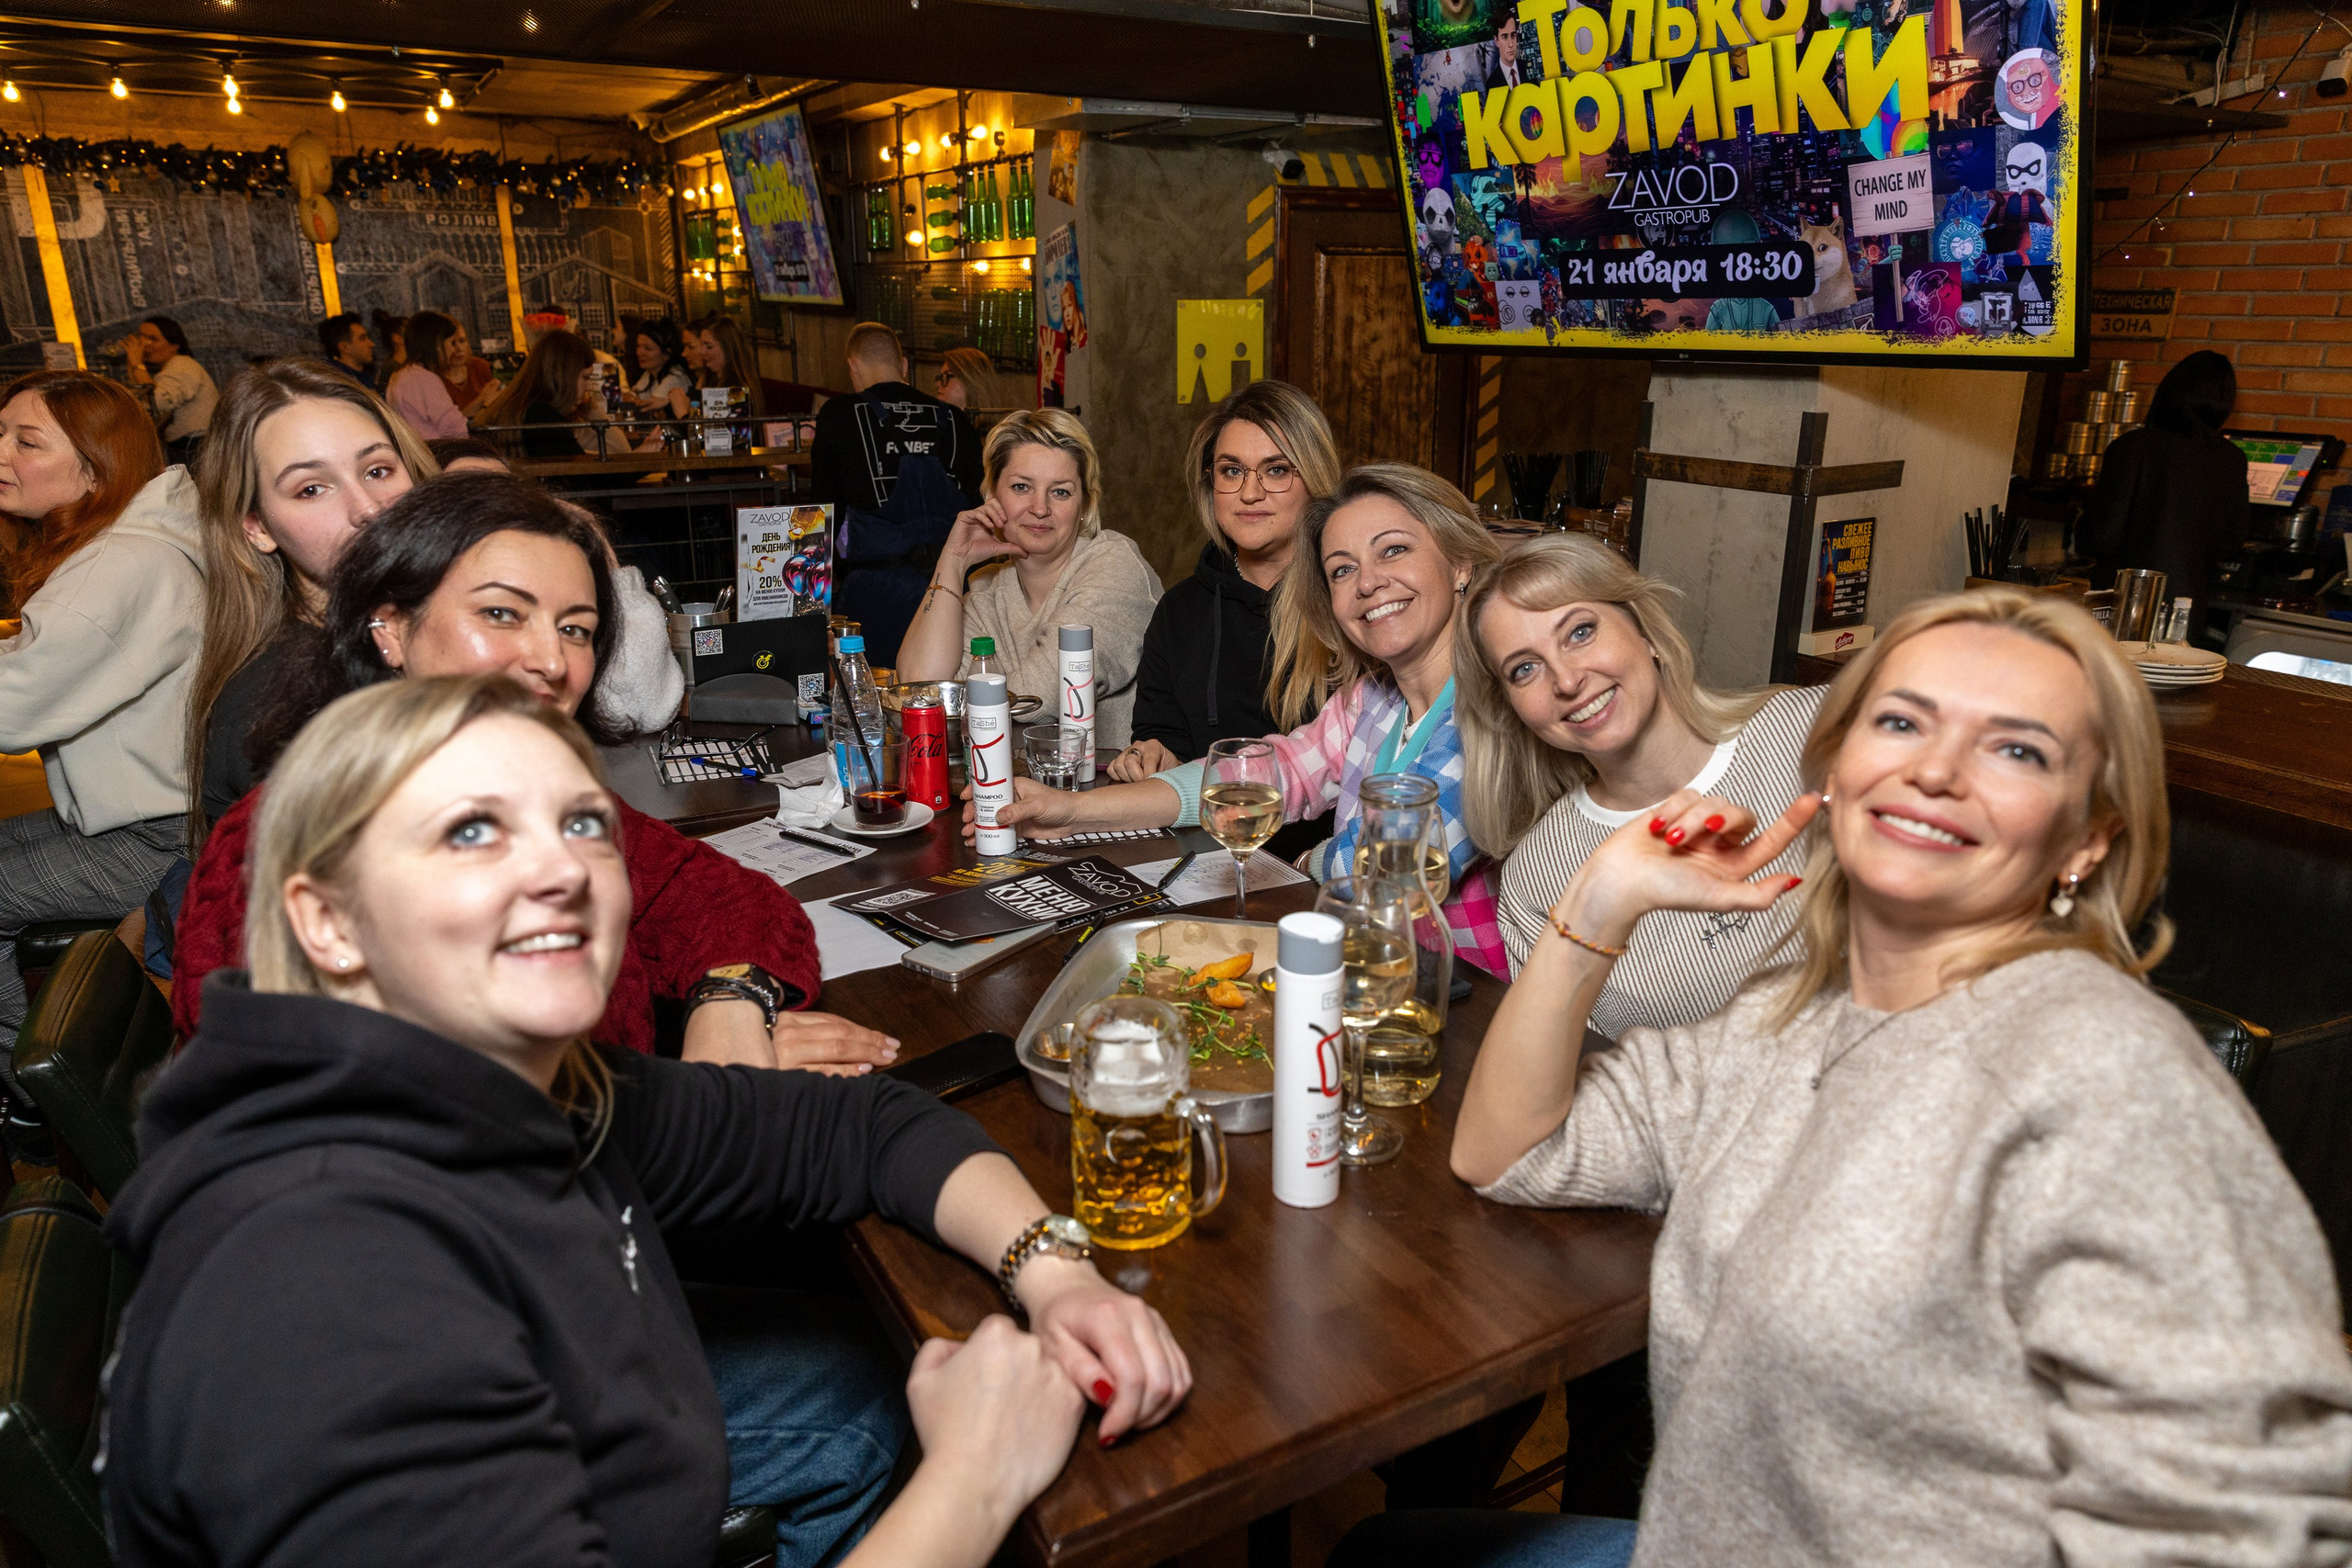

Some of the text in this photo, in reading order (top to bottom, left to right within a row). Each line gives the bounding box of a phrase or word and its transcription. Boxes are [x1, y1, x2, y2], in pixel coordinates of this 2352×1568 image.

[1605, 163, 1739, 209] ZAVOD
[1854, 169, 1927, 197] CHANGE MY
[1874, 199, 1908, 220] MIND
[425, 213, 498, 227] РОЗЛИВ
[1634, 209, 1710, 227] GASTROPUB
[1568, 250, 1803, 293] 21 января 18:30
[2099, 317, 2153, 333] ЗОНА
[750, 512, 790, 524] ZAVOD
[1843, 522, 1873, 536] СВЕЖЕЕ
[762, 532, 781, 543] ДЕНЬ
[1832, 534, 1871, 550] РАЗЛИВНОЕ
[752, 542, 791, 554] РОЖДЕНИЯ
[1849, 546, 1870, 560] ПИВО
[1837, 558, 1869, 573] НАВЫНОС
[759, 575, 782, 588] 20%
[910, 731, 944, 759] Cola
[1068, 866, 1131, 897] ZAVOD
[989, 883, 1066, 920] КУХНИ
[1016, 875, 1091, 913] МЕНЮ
